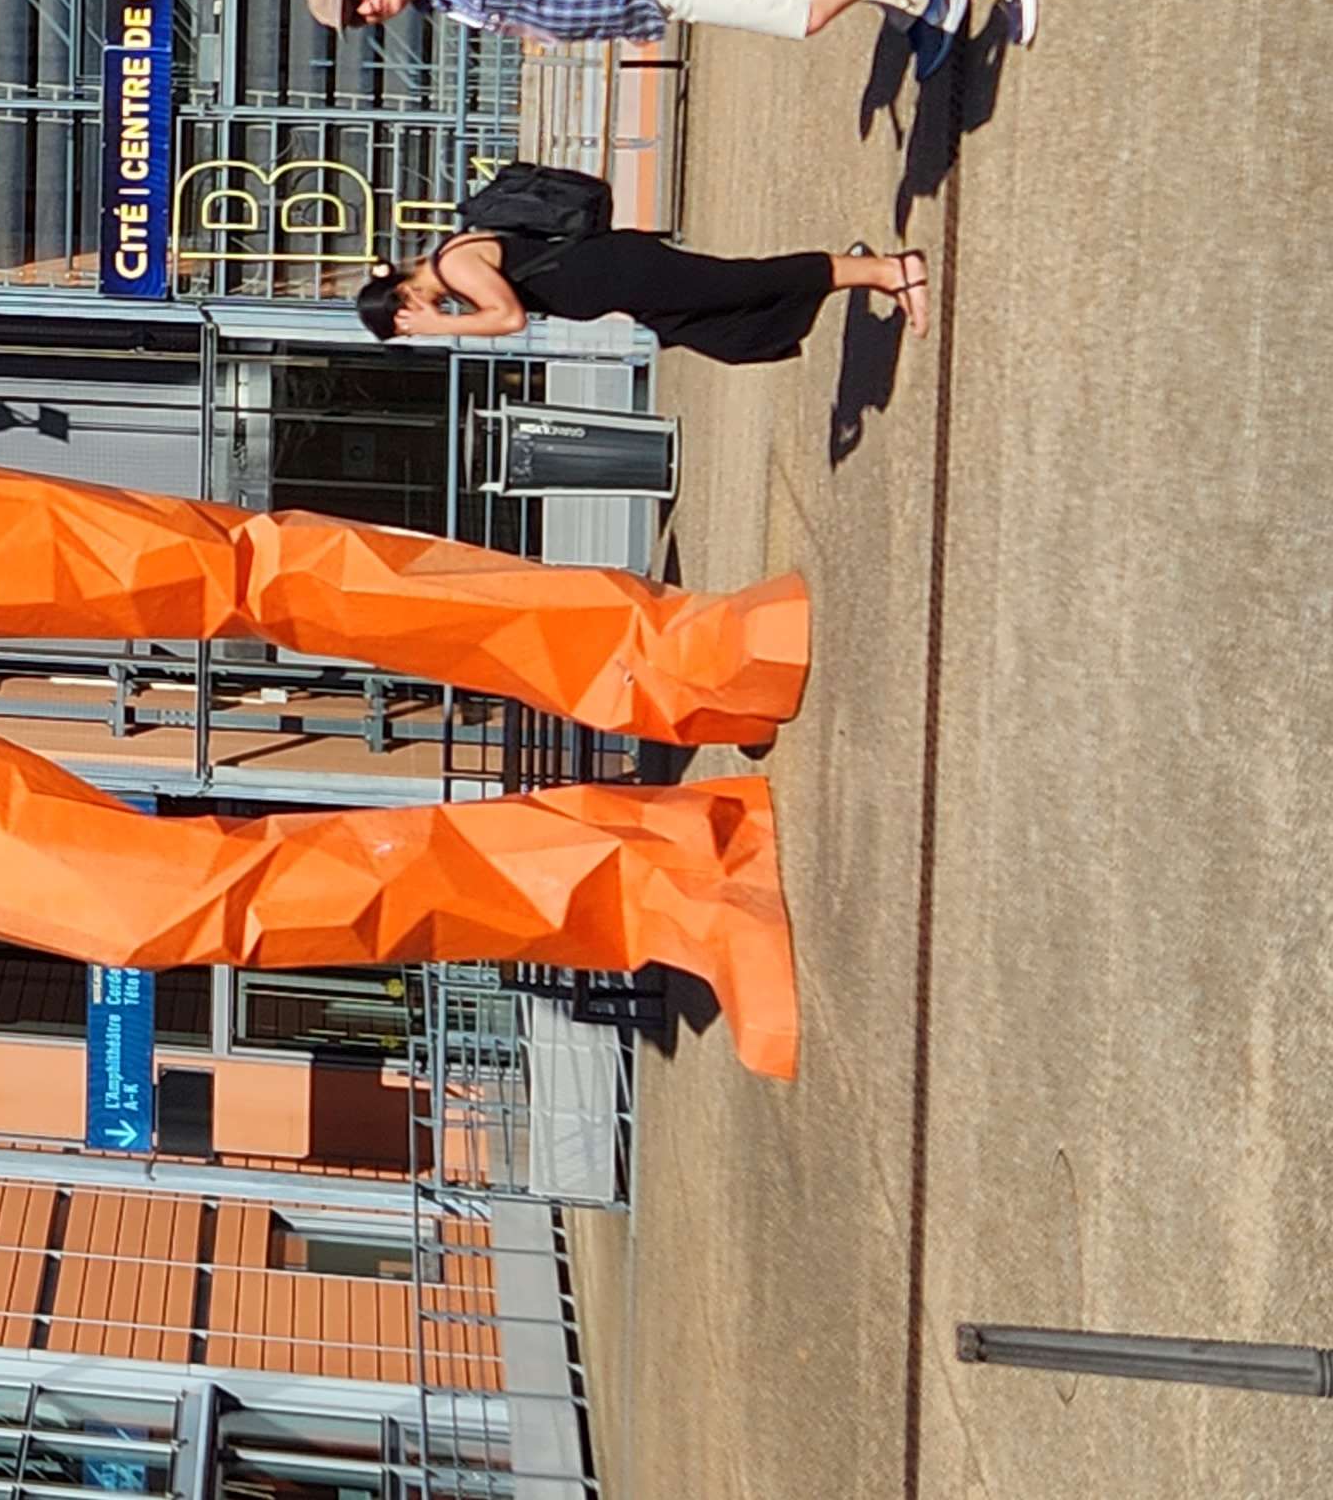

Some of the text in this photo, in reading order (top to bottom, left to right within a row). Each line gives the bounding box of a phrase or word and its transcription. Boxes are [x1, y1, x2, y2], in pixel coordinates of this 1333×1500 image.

[123, 8, 153, 48] DE
[120, 57, 151, 180] CENTRE
[105, 1013, 125, 1109] L'Amphithéâtre
